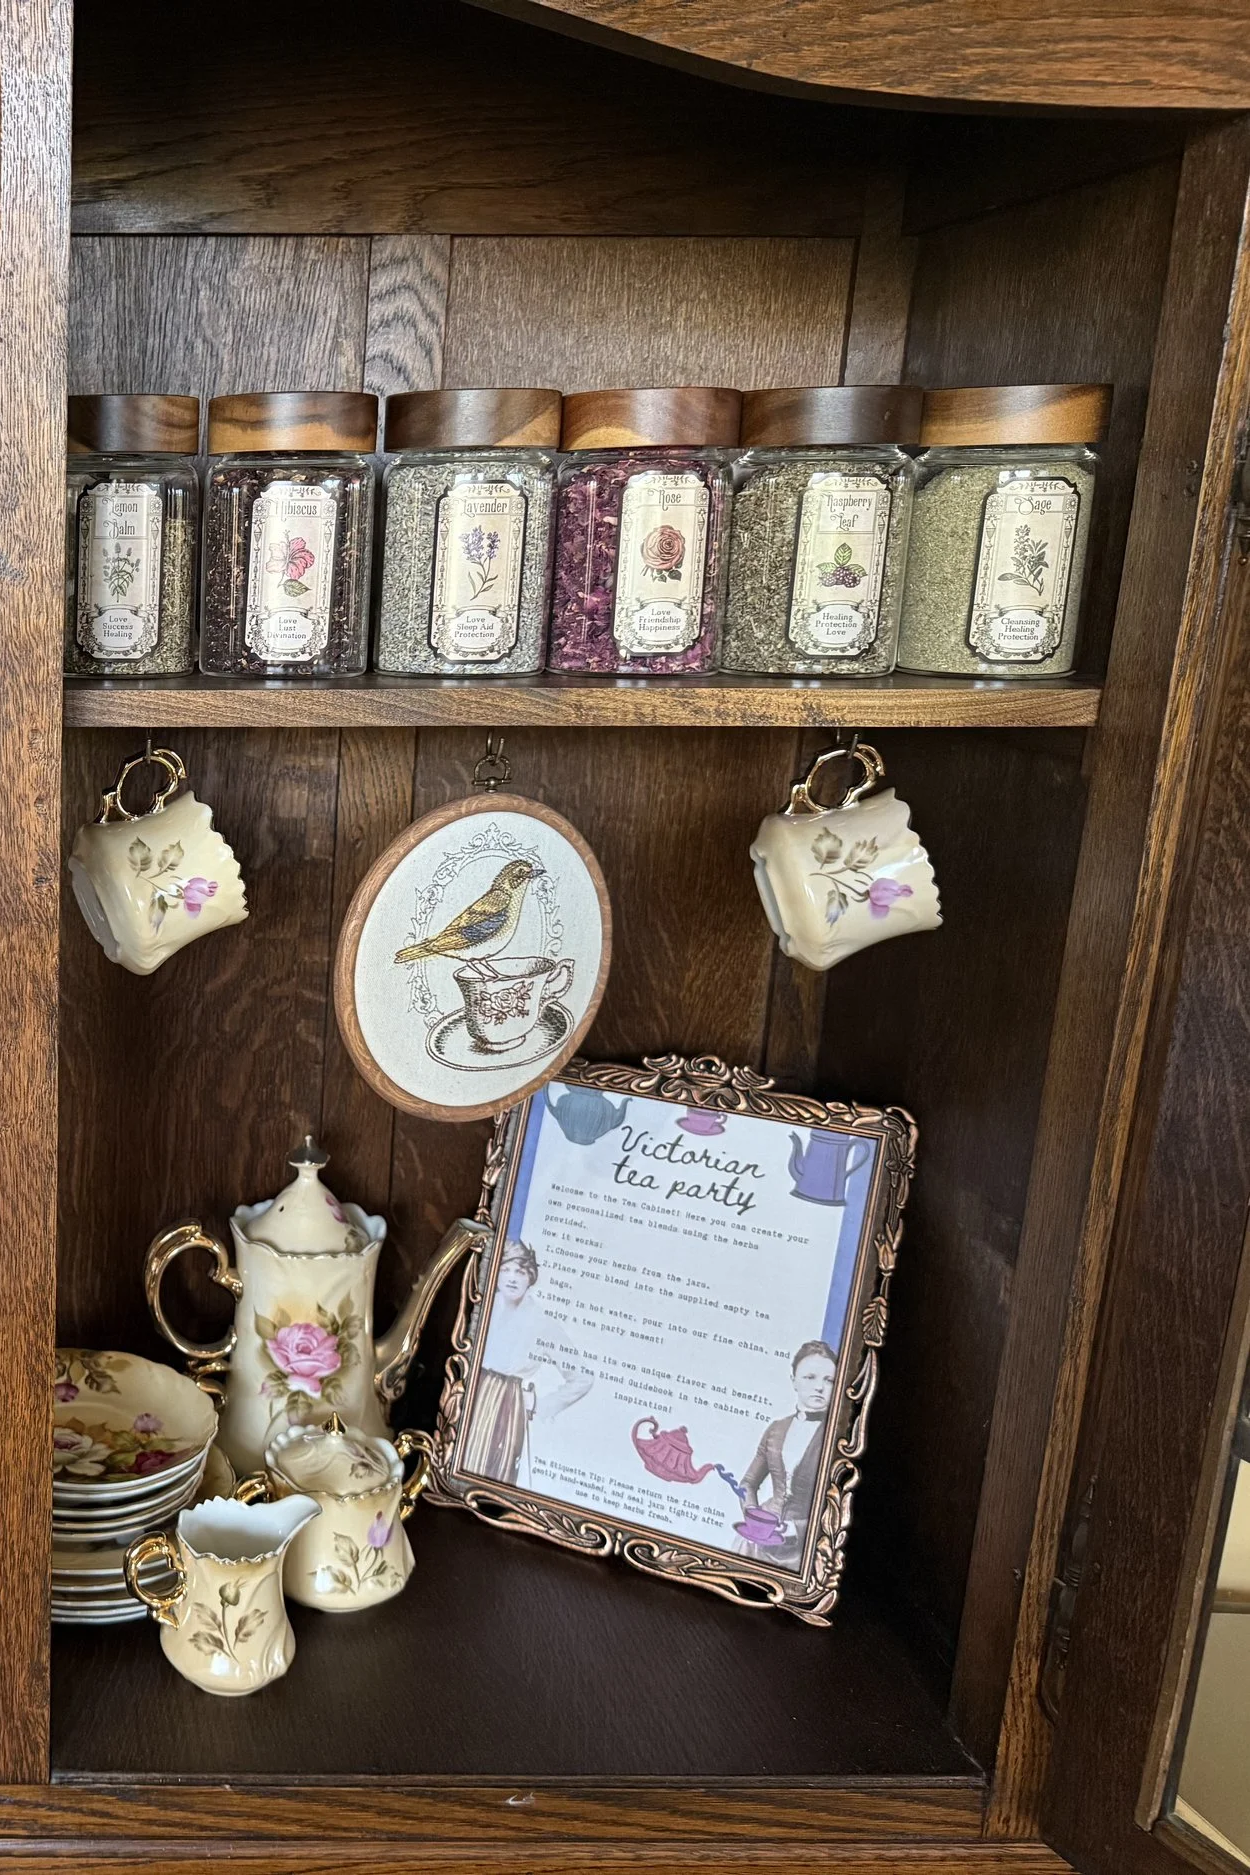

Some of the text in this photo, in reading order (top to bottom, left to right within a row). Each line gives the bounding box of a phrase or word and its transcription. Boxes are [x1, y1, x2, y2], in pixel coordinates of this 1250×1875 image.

[647, 486, 681, 511] Rose
[820, 492, 873, 512] Raspberry
[1014, 496, 1052, 515] Sage
[102, 496, 138, 517] Lemon
[266, 499, 317, 521] Hibiscus
[453, 496, 508, 518] Lavender
[103, 519, 136, 539] Balm
[830, 513, 859, 531] Leaf
[109, 615, 128, 623] Love
[466, 615, 486, 623] Love
[651, 608, 671, 616] Love
[822, 612, 854, 623] Healing
[102, 622, 134, 630] Success
[278, 616, 298, 624] Love
[456, 622, 494, 632] Sleep Aid
[638, 615, 682, 625] Friendship
[815, 620, 858, 628] Protection
[1001, 617, 1041, 628] Cleansing
[103, 629, 133, 640] Healing
[266, 631, 307, 639] Divination
[278, 624, 297, 632] Lust
[638, 623, 681, 633] Happiness
[826, 627, 847, 636] Love
[1004, 625, 1036, 636] Healing
[998, 632, 1039, 641] Protection
[621, 1125, 765, 1179] Victorian
[612, 1154, 756, 1216] tea party
[551, 1183, 584, 1196] Welcome
[588, 1191, 598, 1199] to
[603, 1194, 617, 1203] the
[621, 1197, 637, 1208] Tea
[685, 1210, 706, 1222] Here
[709, 1217, 726, 1227] you
[730, 1222, 746, 1231] can
[750, 1226, 783, 1238] create
[786, 1234, 809, 1244] your
[544, 1214, 586, 1229] provided.
[547, 1198, 562, 1207] own
[629, 1215, 643, 1225] tea
[647, 1219, 678, 1232] blends
[682, 1228, 709, 1241] using
[713, 1233, 728, 1243] the
[732, 1237, 758, 1250] herbs
[541, 1227, 558, 1237] How
[561, 1232, 570, 1241] it
[587, 1255, 710, 1289] your herbs from the jars.
[579, 1269, 769, 1320] your blend into the supplied empty tea
[543, 1309, 568, 1322] enjoy
[582, 1317, 596, 1327] tea
[600, 1323, 626, 1336] party
[575, 1299, 584, 1309] in
[588, 1303, 604, 1313] hot
[641, 1317, 663, 1328] pour
[667, 1322, 687, 1333] into
[691, 1329, 708, 1339] our
[712, 1333, 733, 1344] fine
[773, 1349, 790, 1359] and
[535, 1337, 772, 1406] Each herb has its own unique flavor and benefit.
[561, 1360, 771, 1422] the Tea Guidebook in the cabinet for
[622, 1502, 645, 1515] herbs
